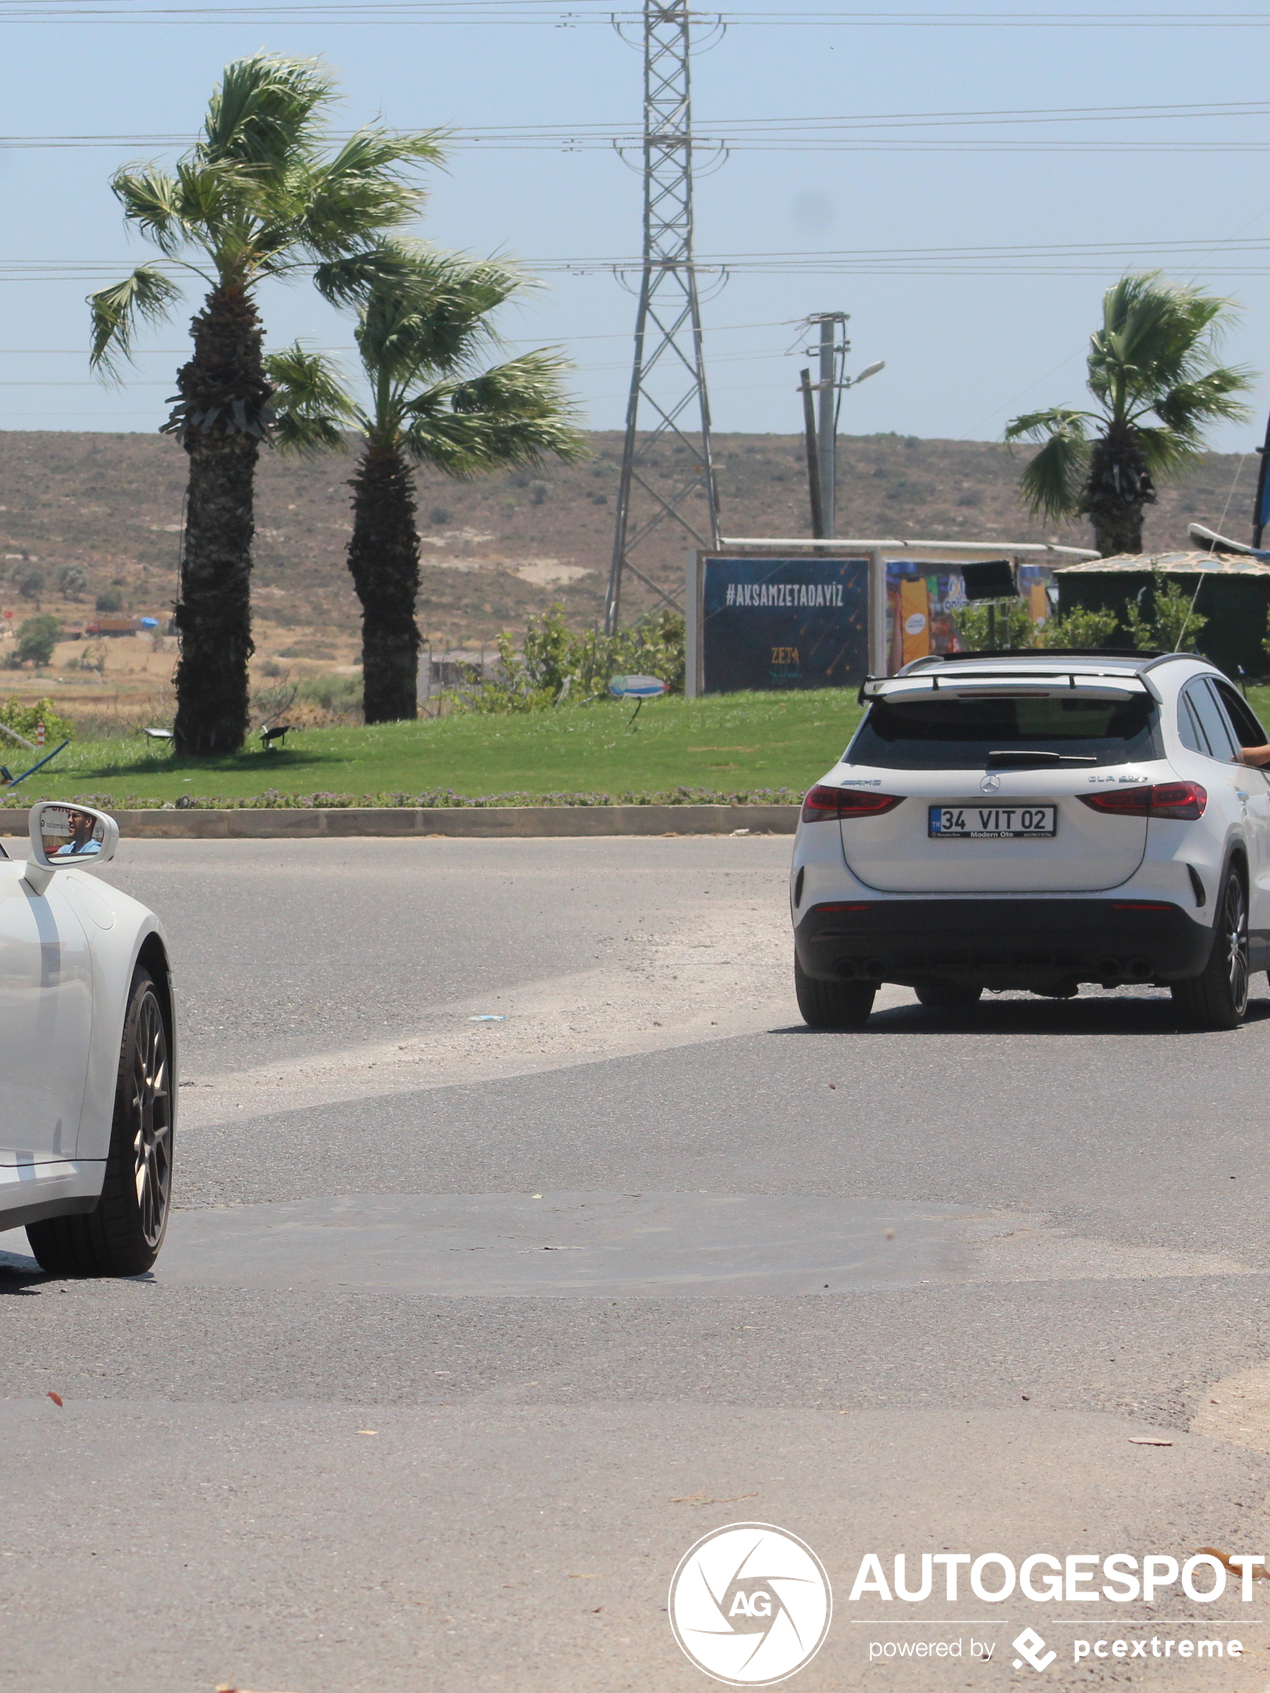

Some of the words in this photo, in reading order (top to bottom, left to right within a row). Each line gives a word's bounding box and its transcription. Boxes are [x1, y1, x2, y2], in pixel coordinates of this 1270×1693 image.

[771, 647, 800, 664] ZETA
[941, 810, 966, 830] 34
[978, 810, 1016, 830] VIT
[1021, 810, 1046, 830] 02
